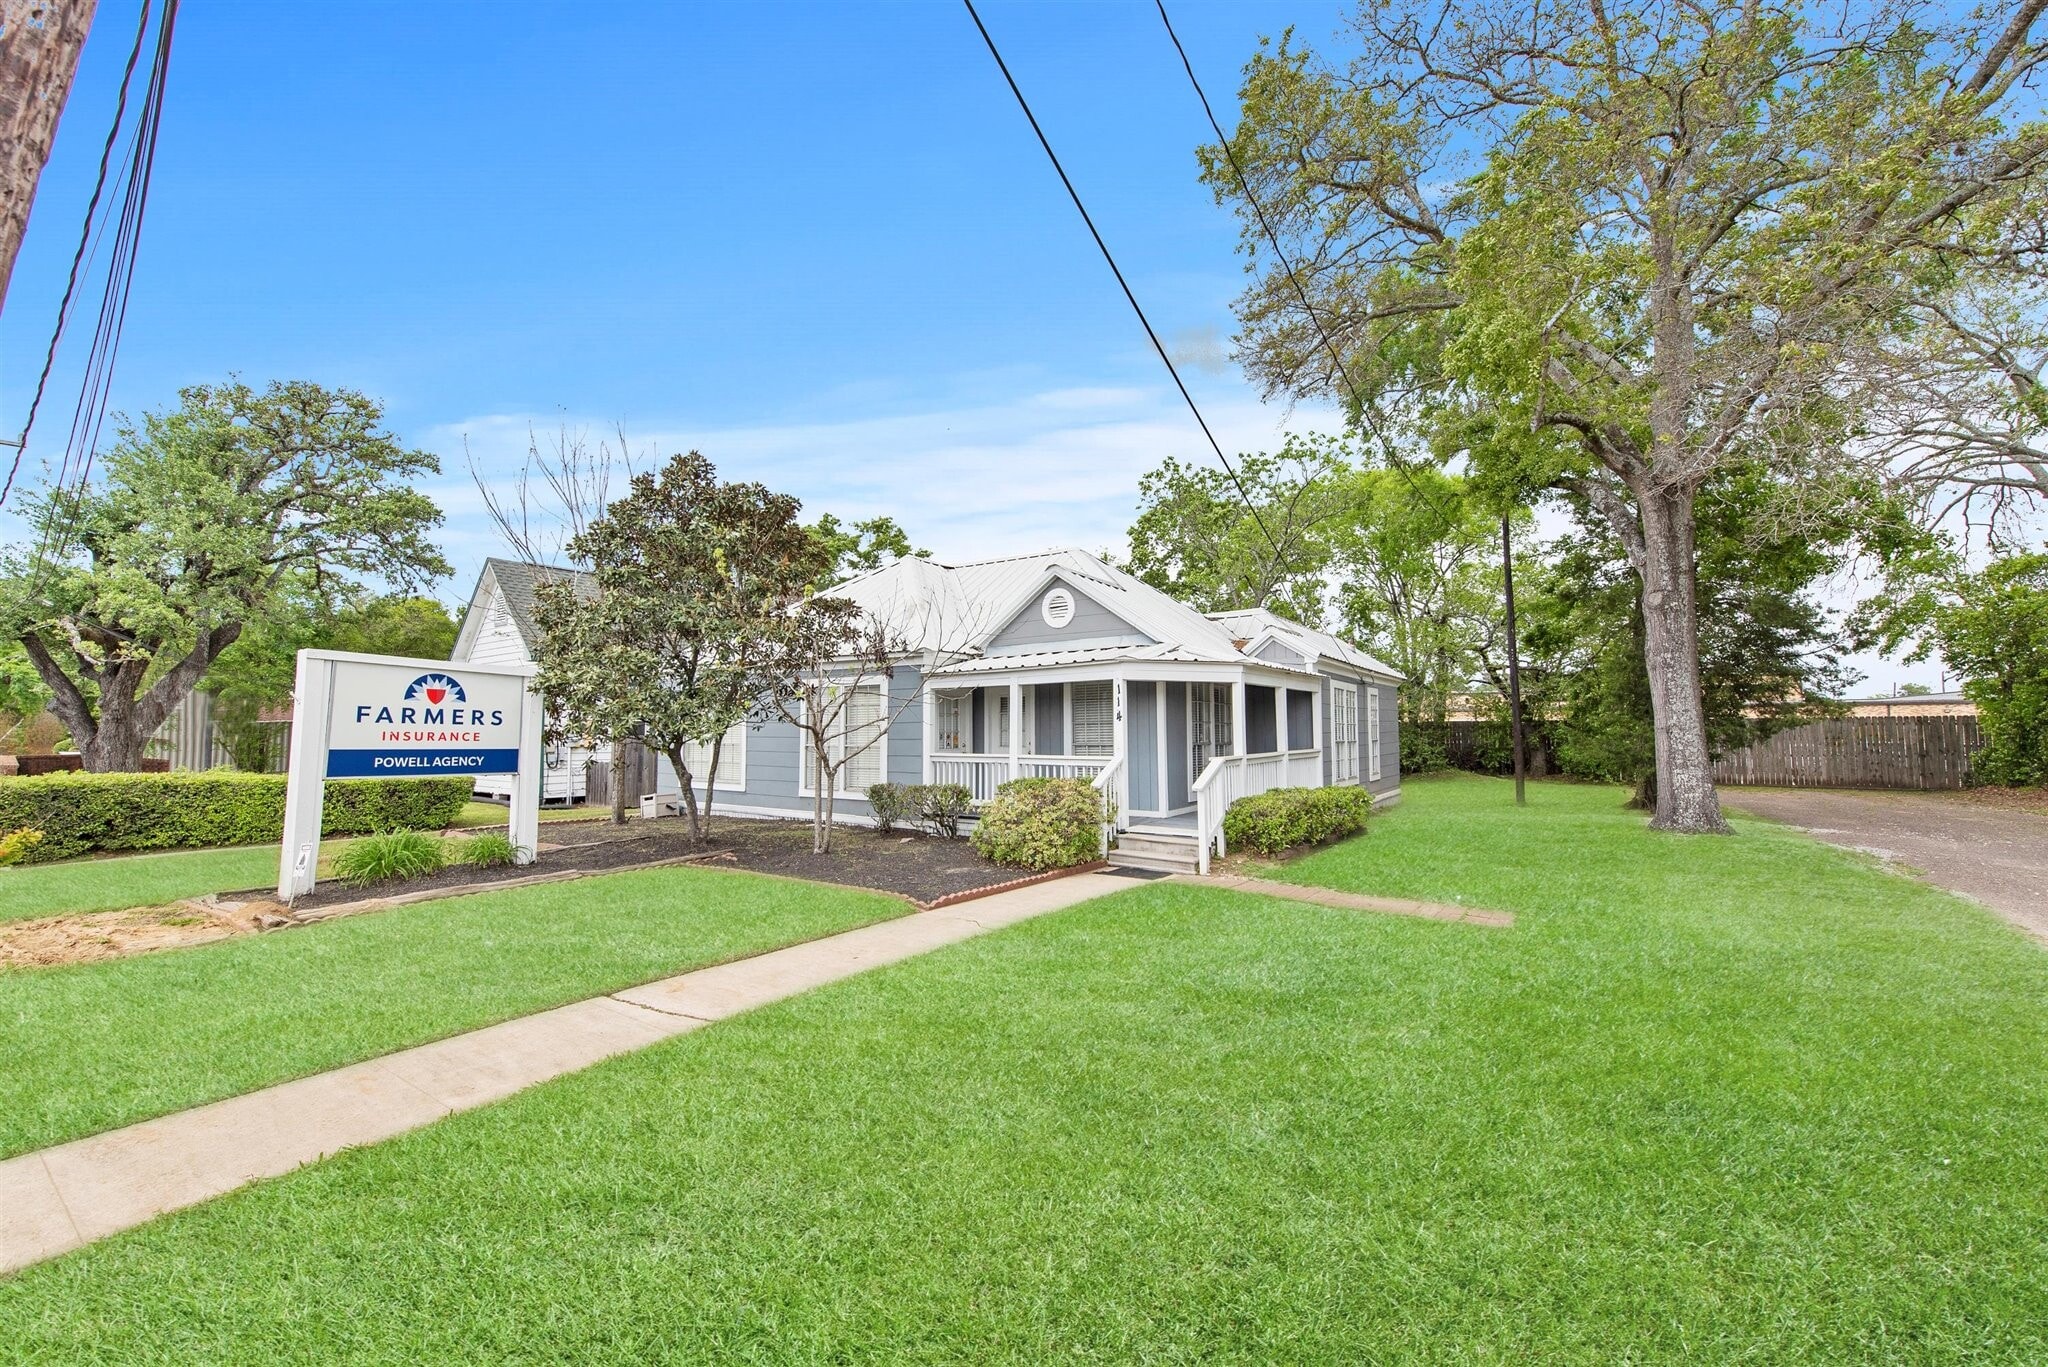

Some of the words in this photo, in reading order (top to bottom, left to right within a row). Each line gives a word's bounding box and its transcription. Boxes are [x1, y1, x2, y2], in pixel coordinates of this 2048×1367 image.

[356, 706, 503, 726] FARMERS
[381, 731, 481, 742] INSURANCE
[374, 757, 430, 768] POWELL
[432, 756, 485, 767] AGENCY
